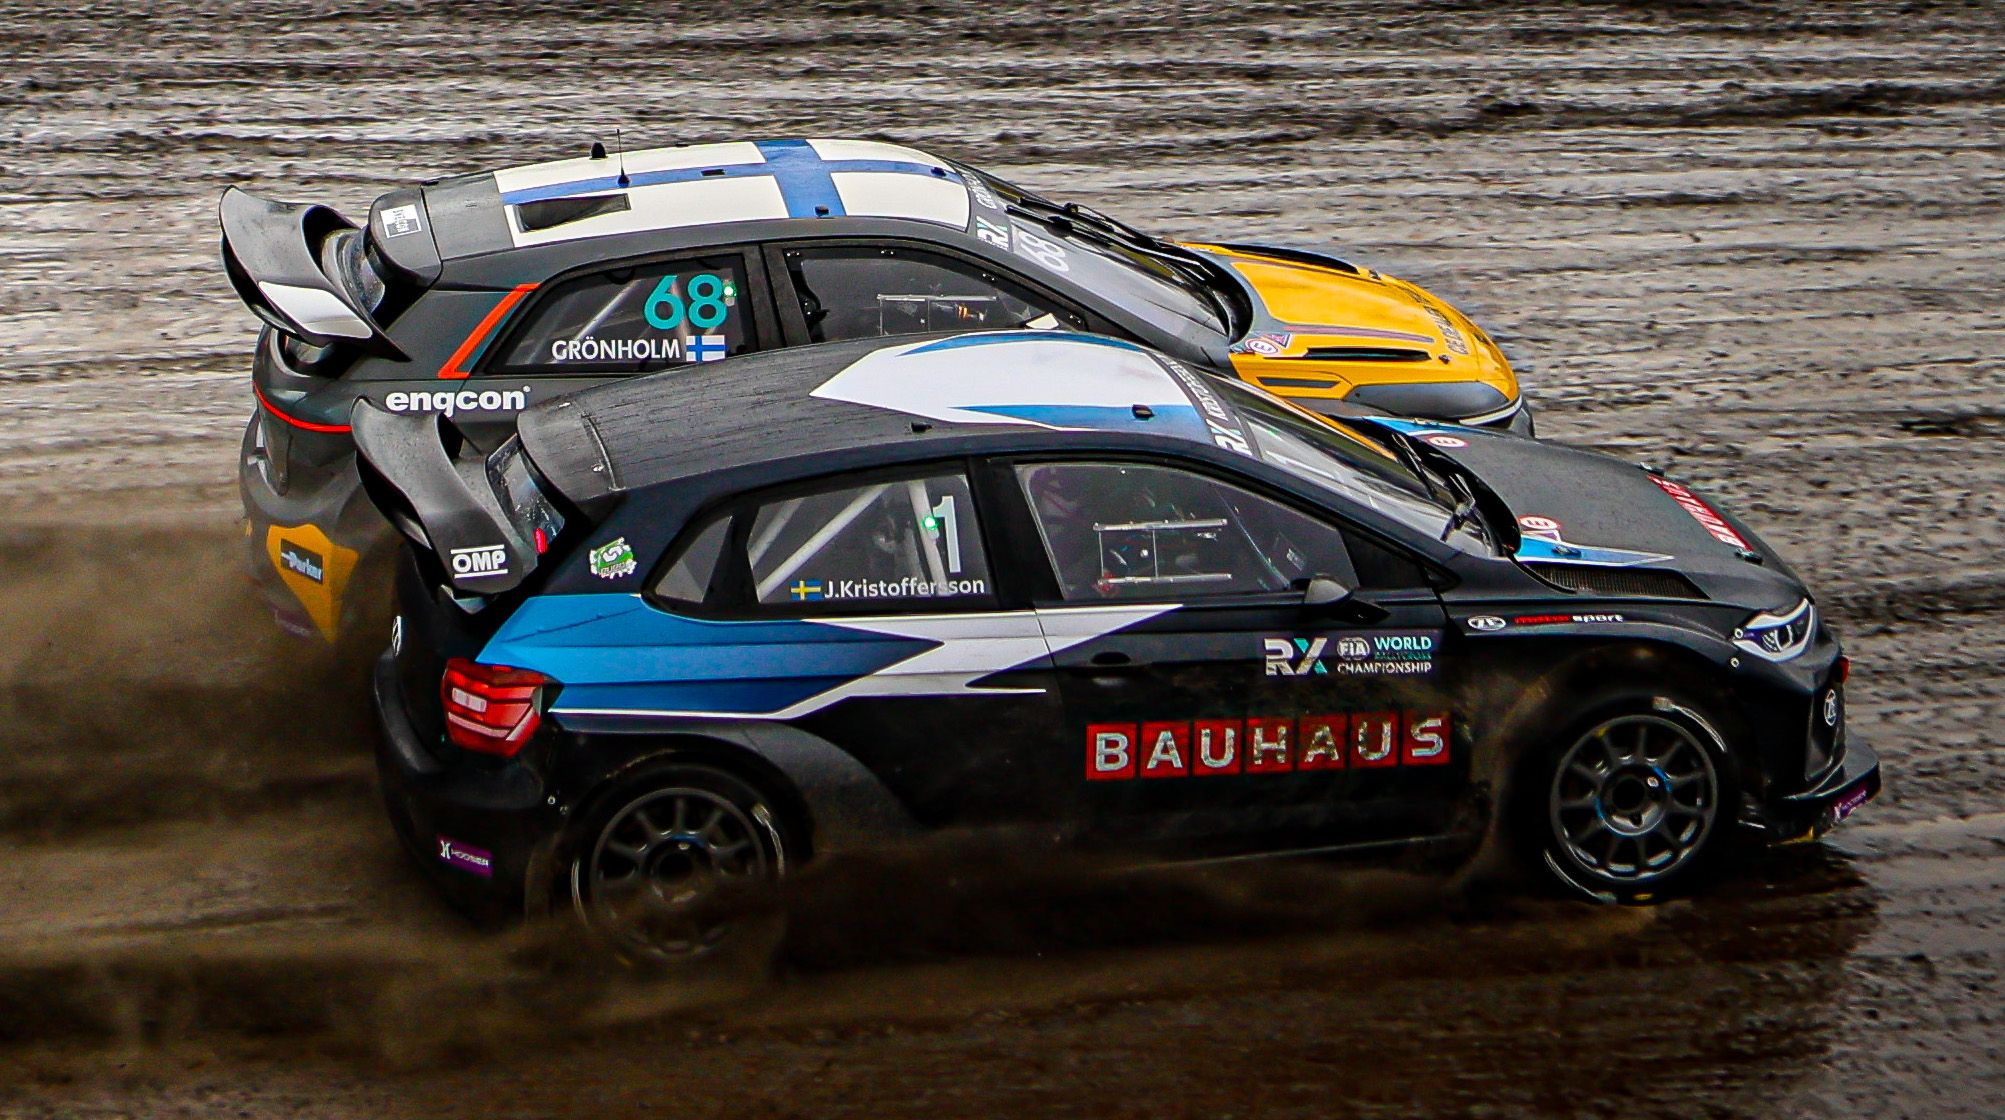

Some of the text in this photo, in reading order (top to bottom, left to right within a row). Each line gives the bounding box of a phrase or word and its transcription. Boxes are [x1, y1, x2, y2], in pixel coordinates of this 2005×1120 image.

[1018, 230, 1070, 272] 68
[644, 274, 728, 329] 68
[551, 336, 680, 360] GRÖNHOLM
[933, 496, 961, 572] 1
[453, 550, 506, 573] OMP
[824, 577, 985, 598] J.Kristoffersson
[1338, 640, 1368, 657] FIA
[1374, 637, 1432, 650] WORLD
[1264, 638, 1328, 676] RX
[1337, 662, 1432, 674] CHAMPIONSHIP
[1095, 718, 1444, 771] BAUHAUS
